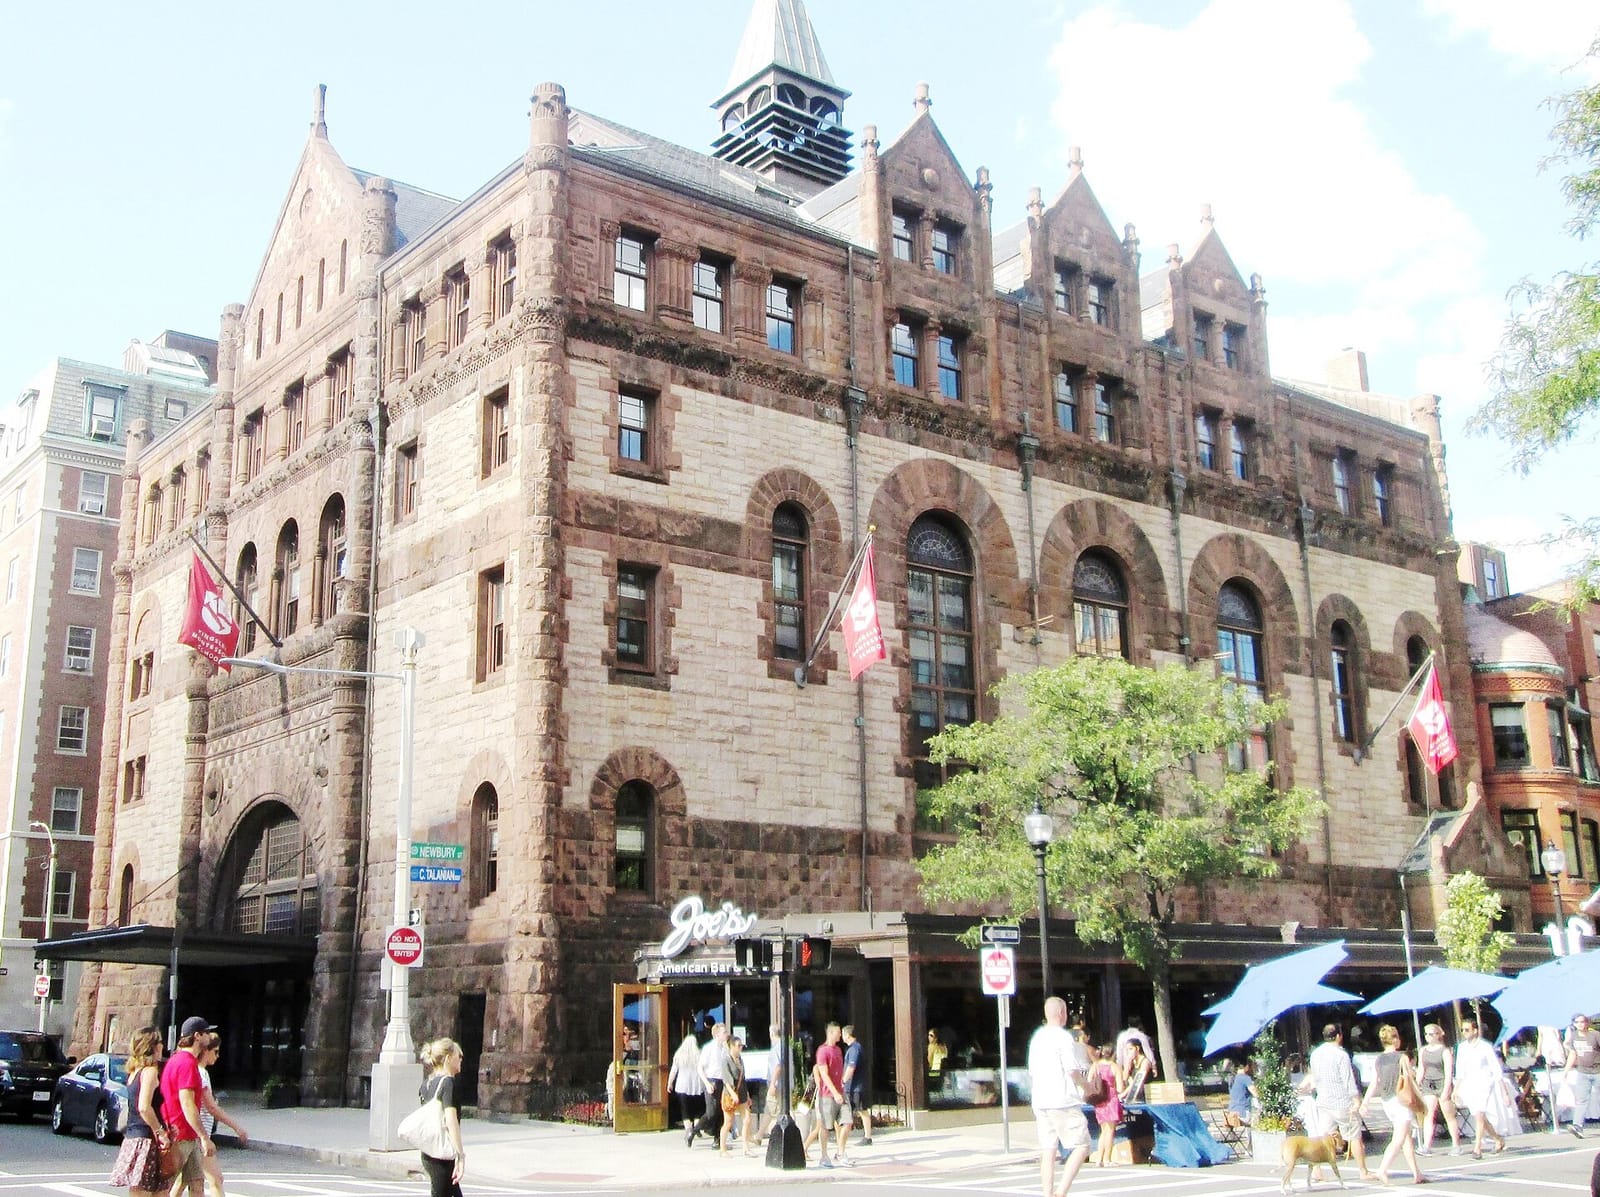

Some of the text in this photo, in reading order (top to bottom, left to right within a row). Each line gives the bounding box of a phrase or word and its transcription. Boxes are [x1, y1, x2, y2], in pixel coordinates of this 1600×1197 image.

[420, 846, 456, 858] NEWBURY
[661, 896, 757, 957] Joe's
[391, 935, 402, 943] DO
[657, 962, 707, 973] American
[711, 962, 729, 973] Bar
